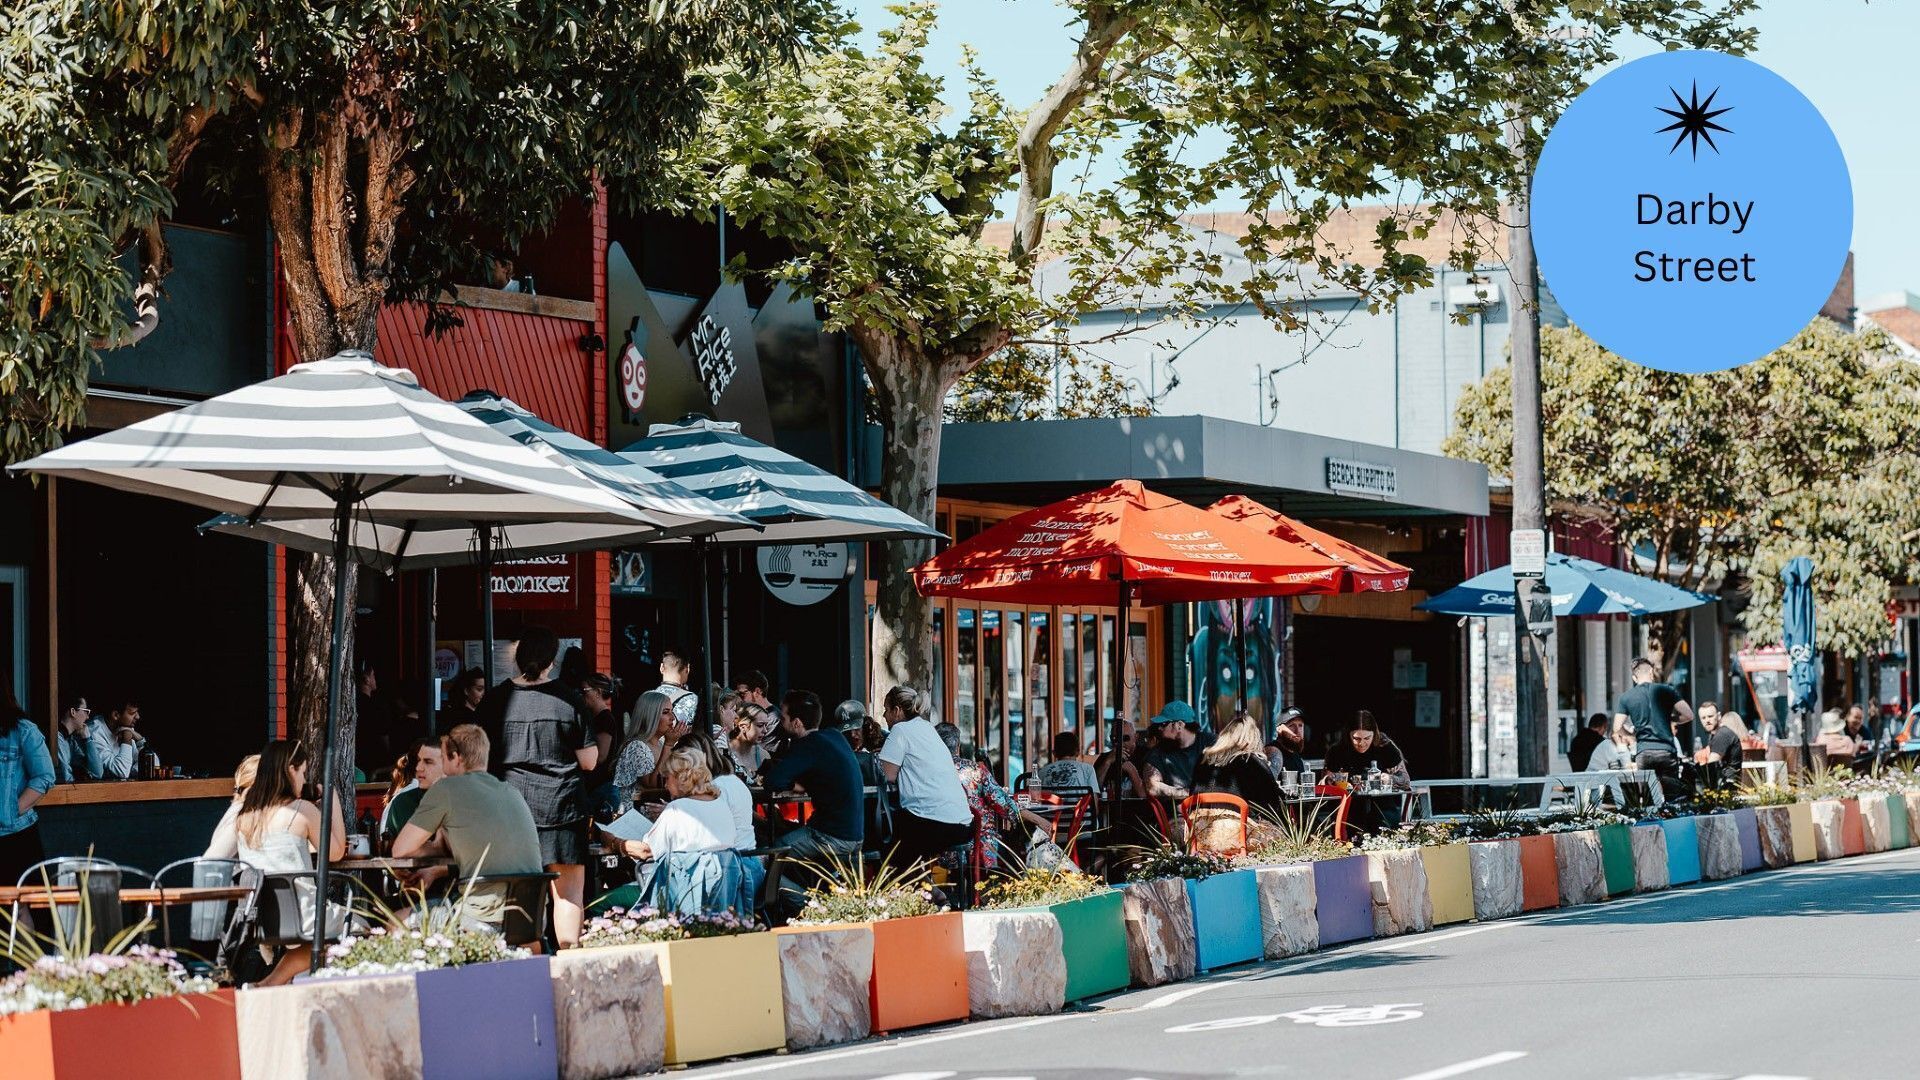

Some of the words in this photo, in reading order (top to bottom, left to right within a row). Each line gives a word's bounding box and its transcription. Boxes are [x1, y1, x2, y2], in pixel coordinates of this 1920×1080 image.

[691, 314, 717, 356] Mr.
[1331, 462, 1355, 485] BEACH
[1357, 466, 1384, 490] BURRITO
[1386, 471, 1395, 493] CO
[490, 575, 570, 594] monkey
[1209, 570, 1251, 582] monkey
